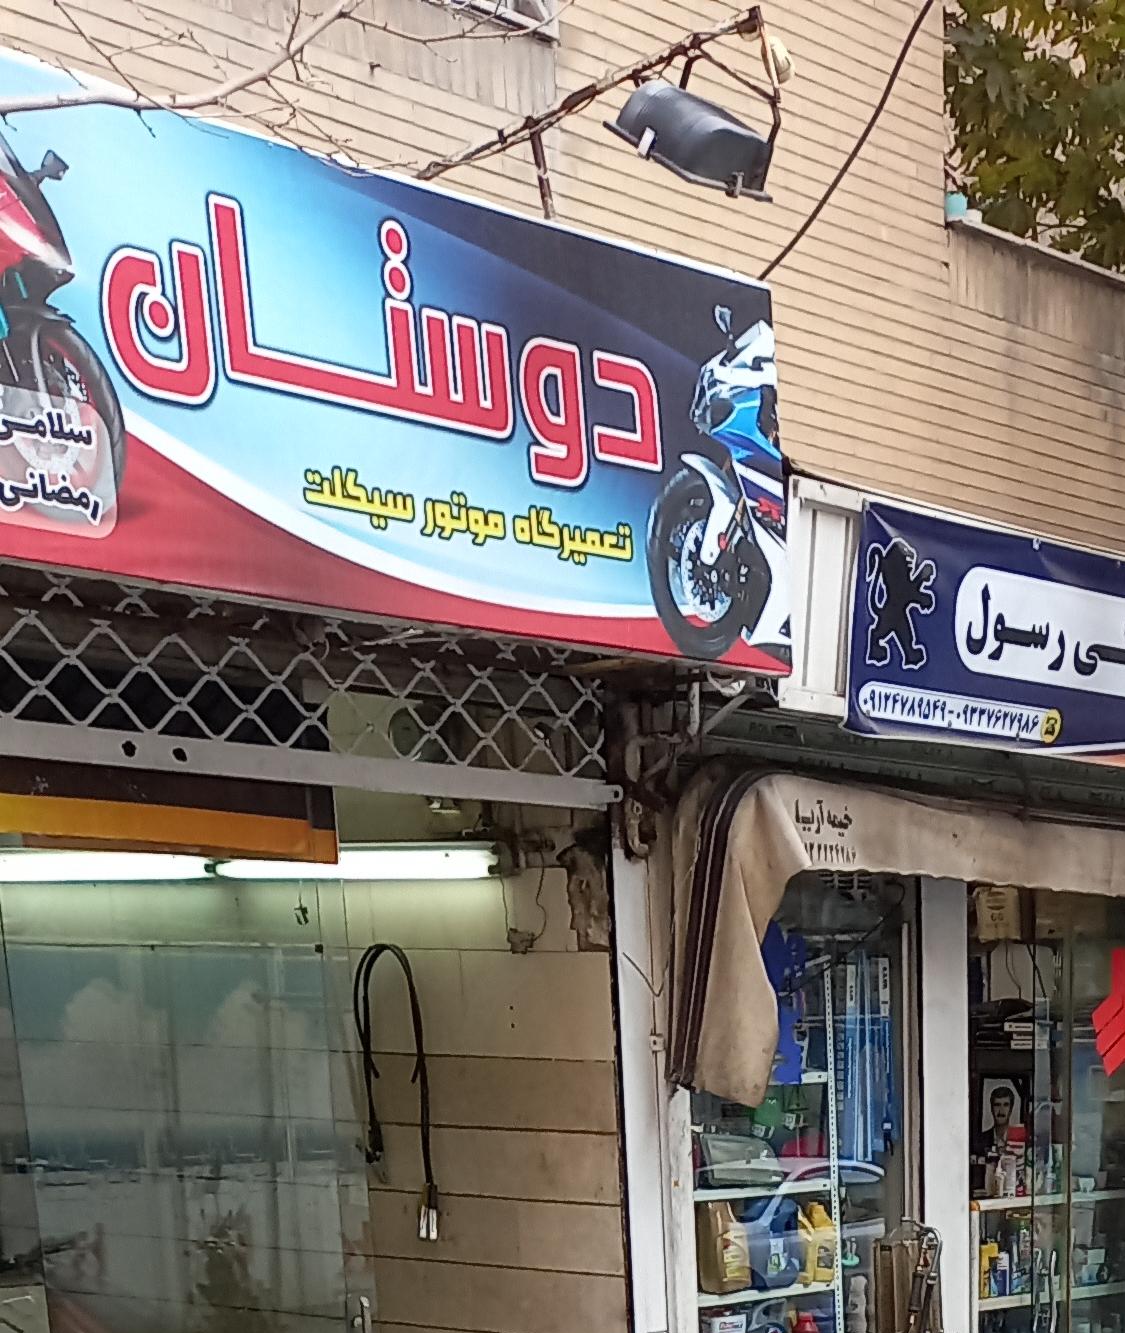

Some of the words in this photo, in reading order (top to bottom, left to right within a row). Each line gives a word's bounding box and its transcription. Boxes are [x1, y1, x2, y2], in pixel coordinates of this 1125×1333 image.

[103, 196, 661, 488] دوستان
[303, 466, 414, 530] سیکلت
[421, 491, 505, 545] موتور
[514, 505, 632, 564] تعمیرگاه
[966, 585, 1066, 671] رسول
